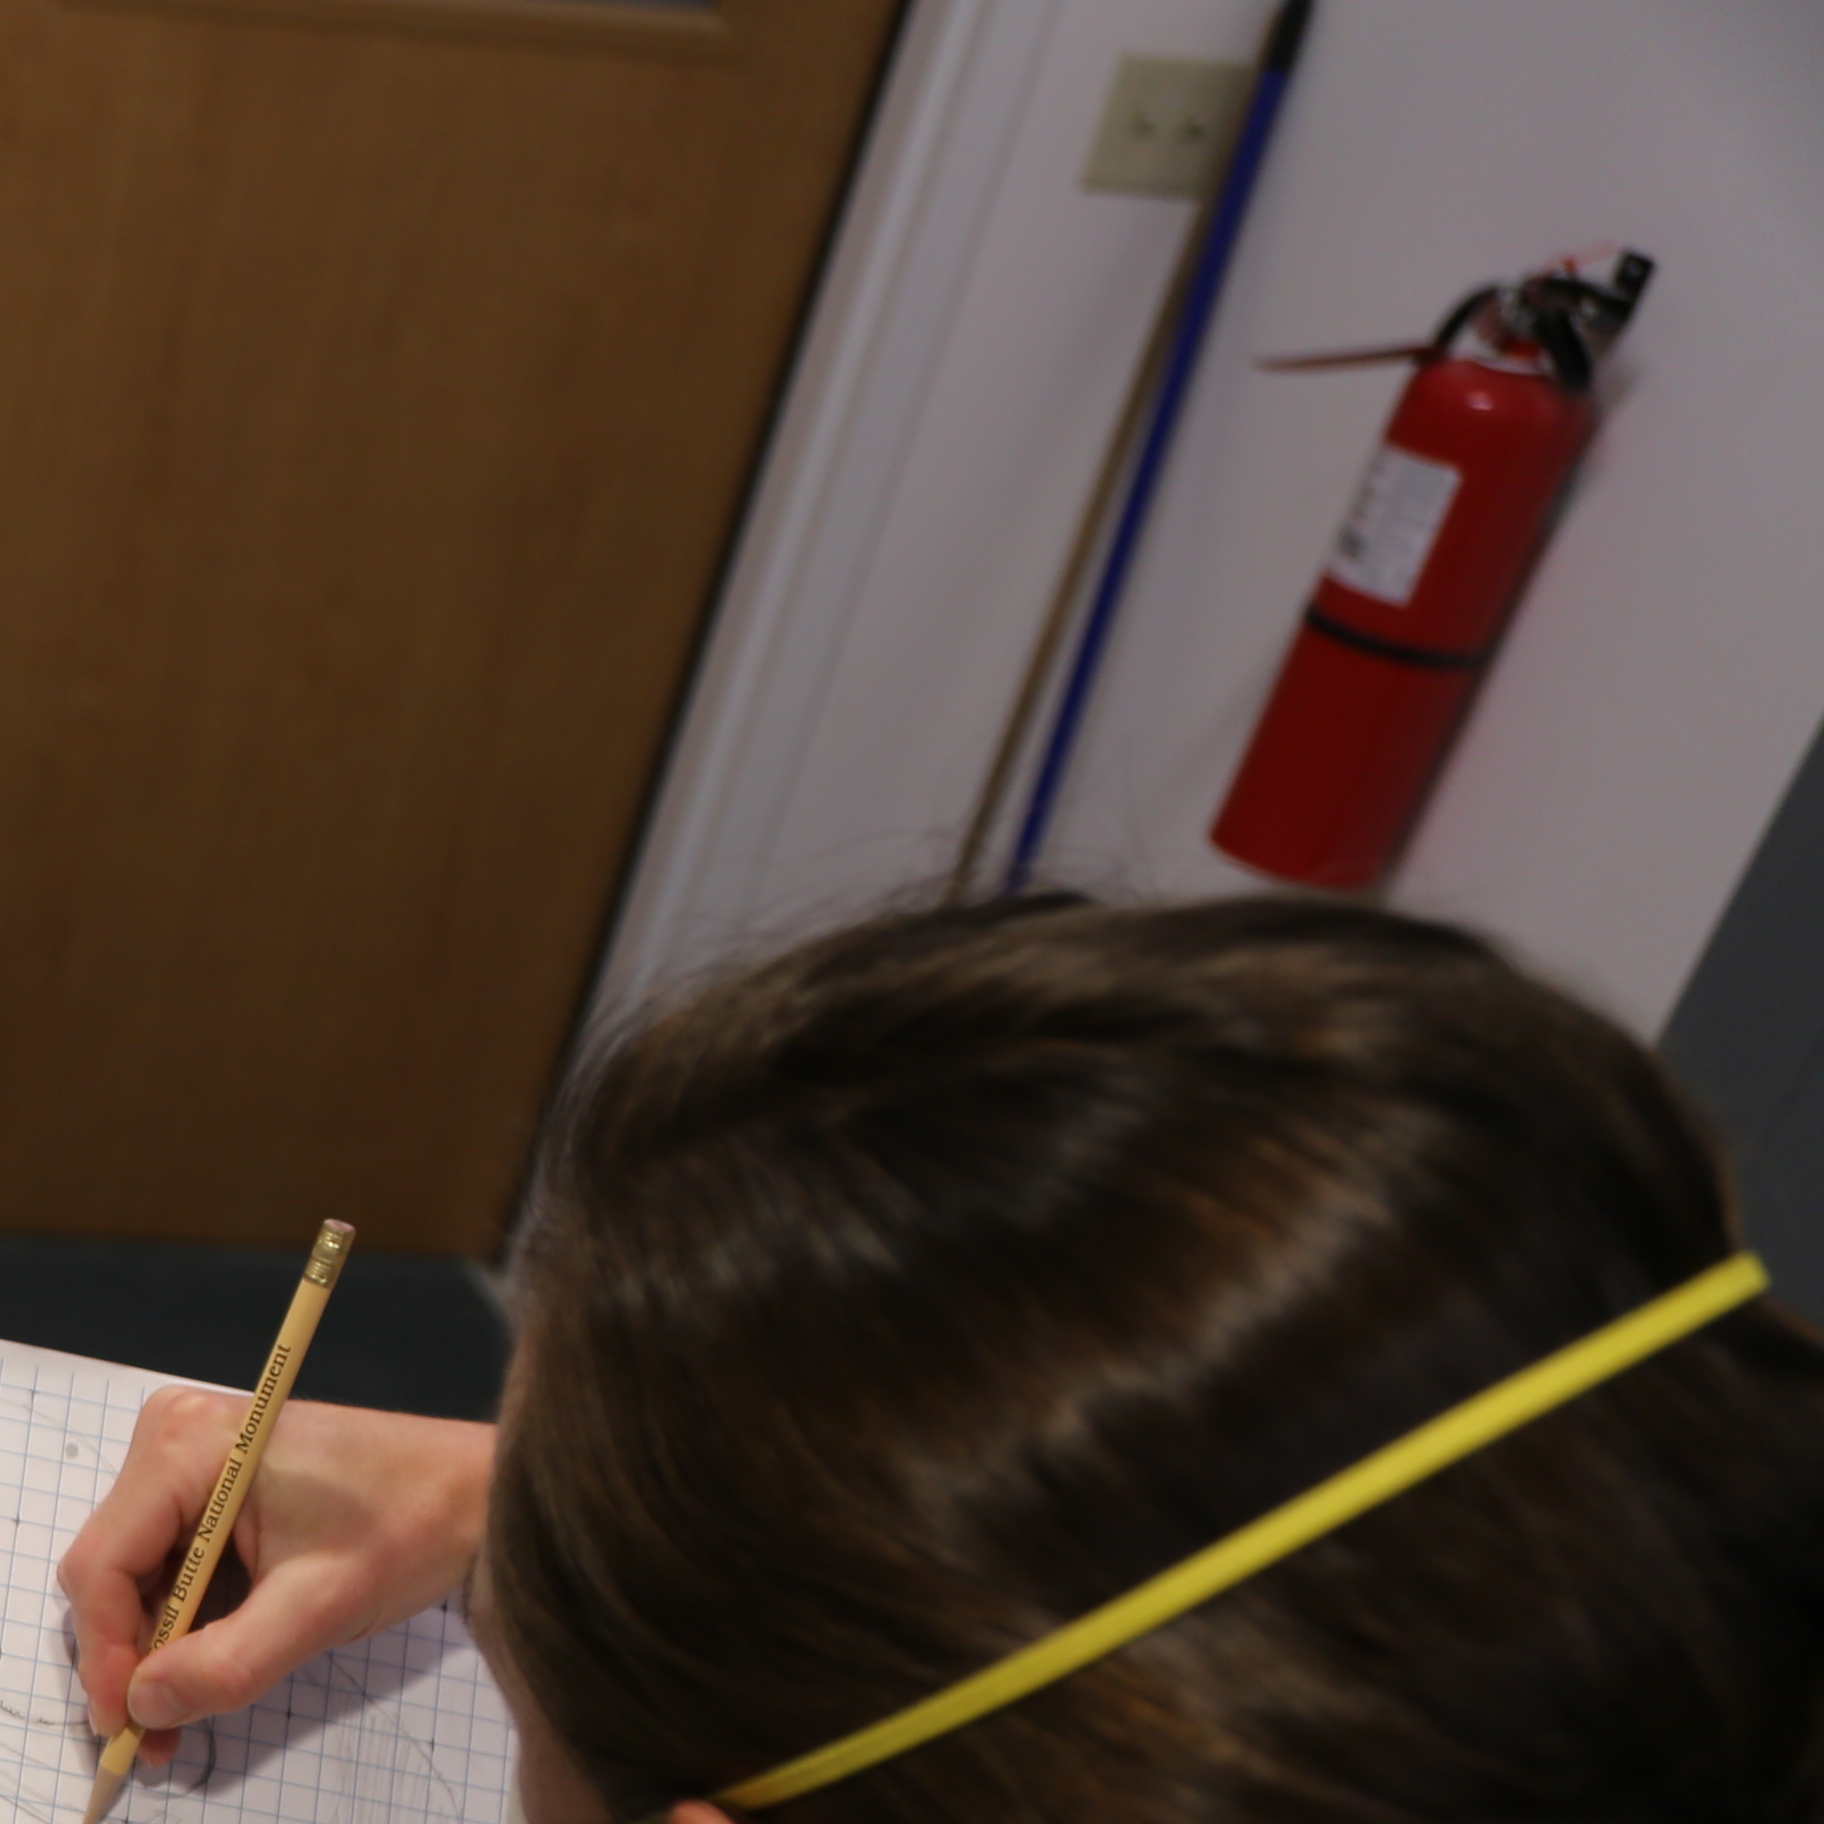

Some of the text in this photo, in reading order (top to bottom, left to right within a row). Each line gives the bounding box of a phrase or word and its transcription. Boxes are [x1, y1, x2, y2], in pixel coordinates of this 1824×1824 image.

[149, 1343, 291, 1651] ossil Butte National Monument
